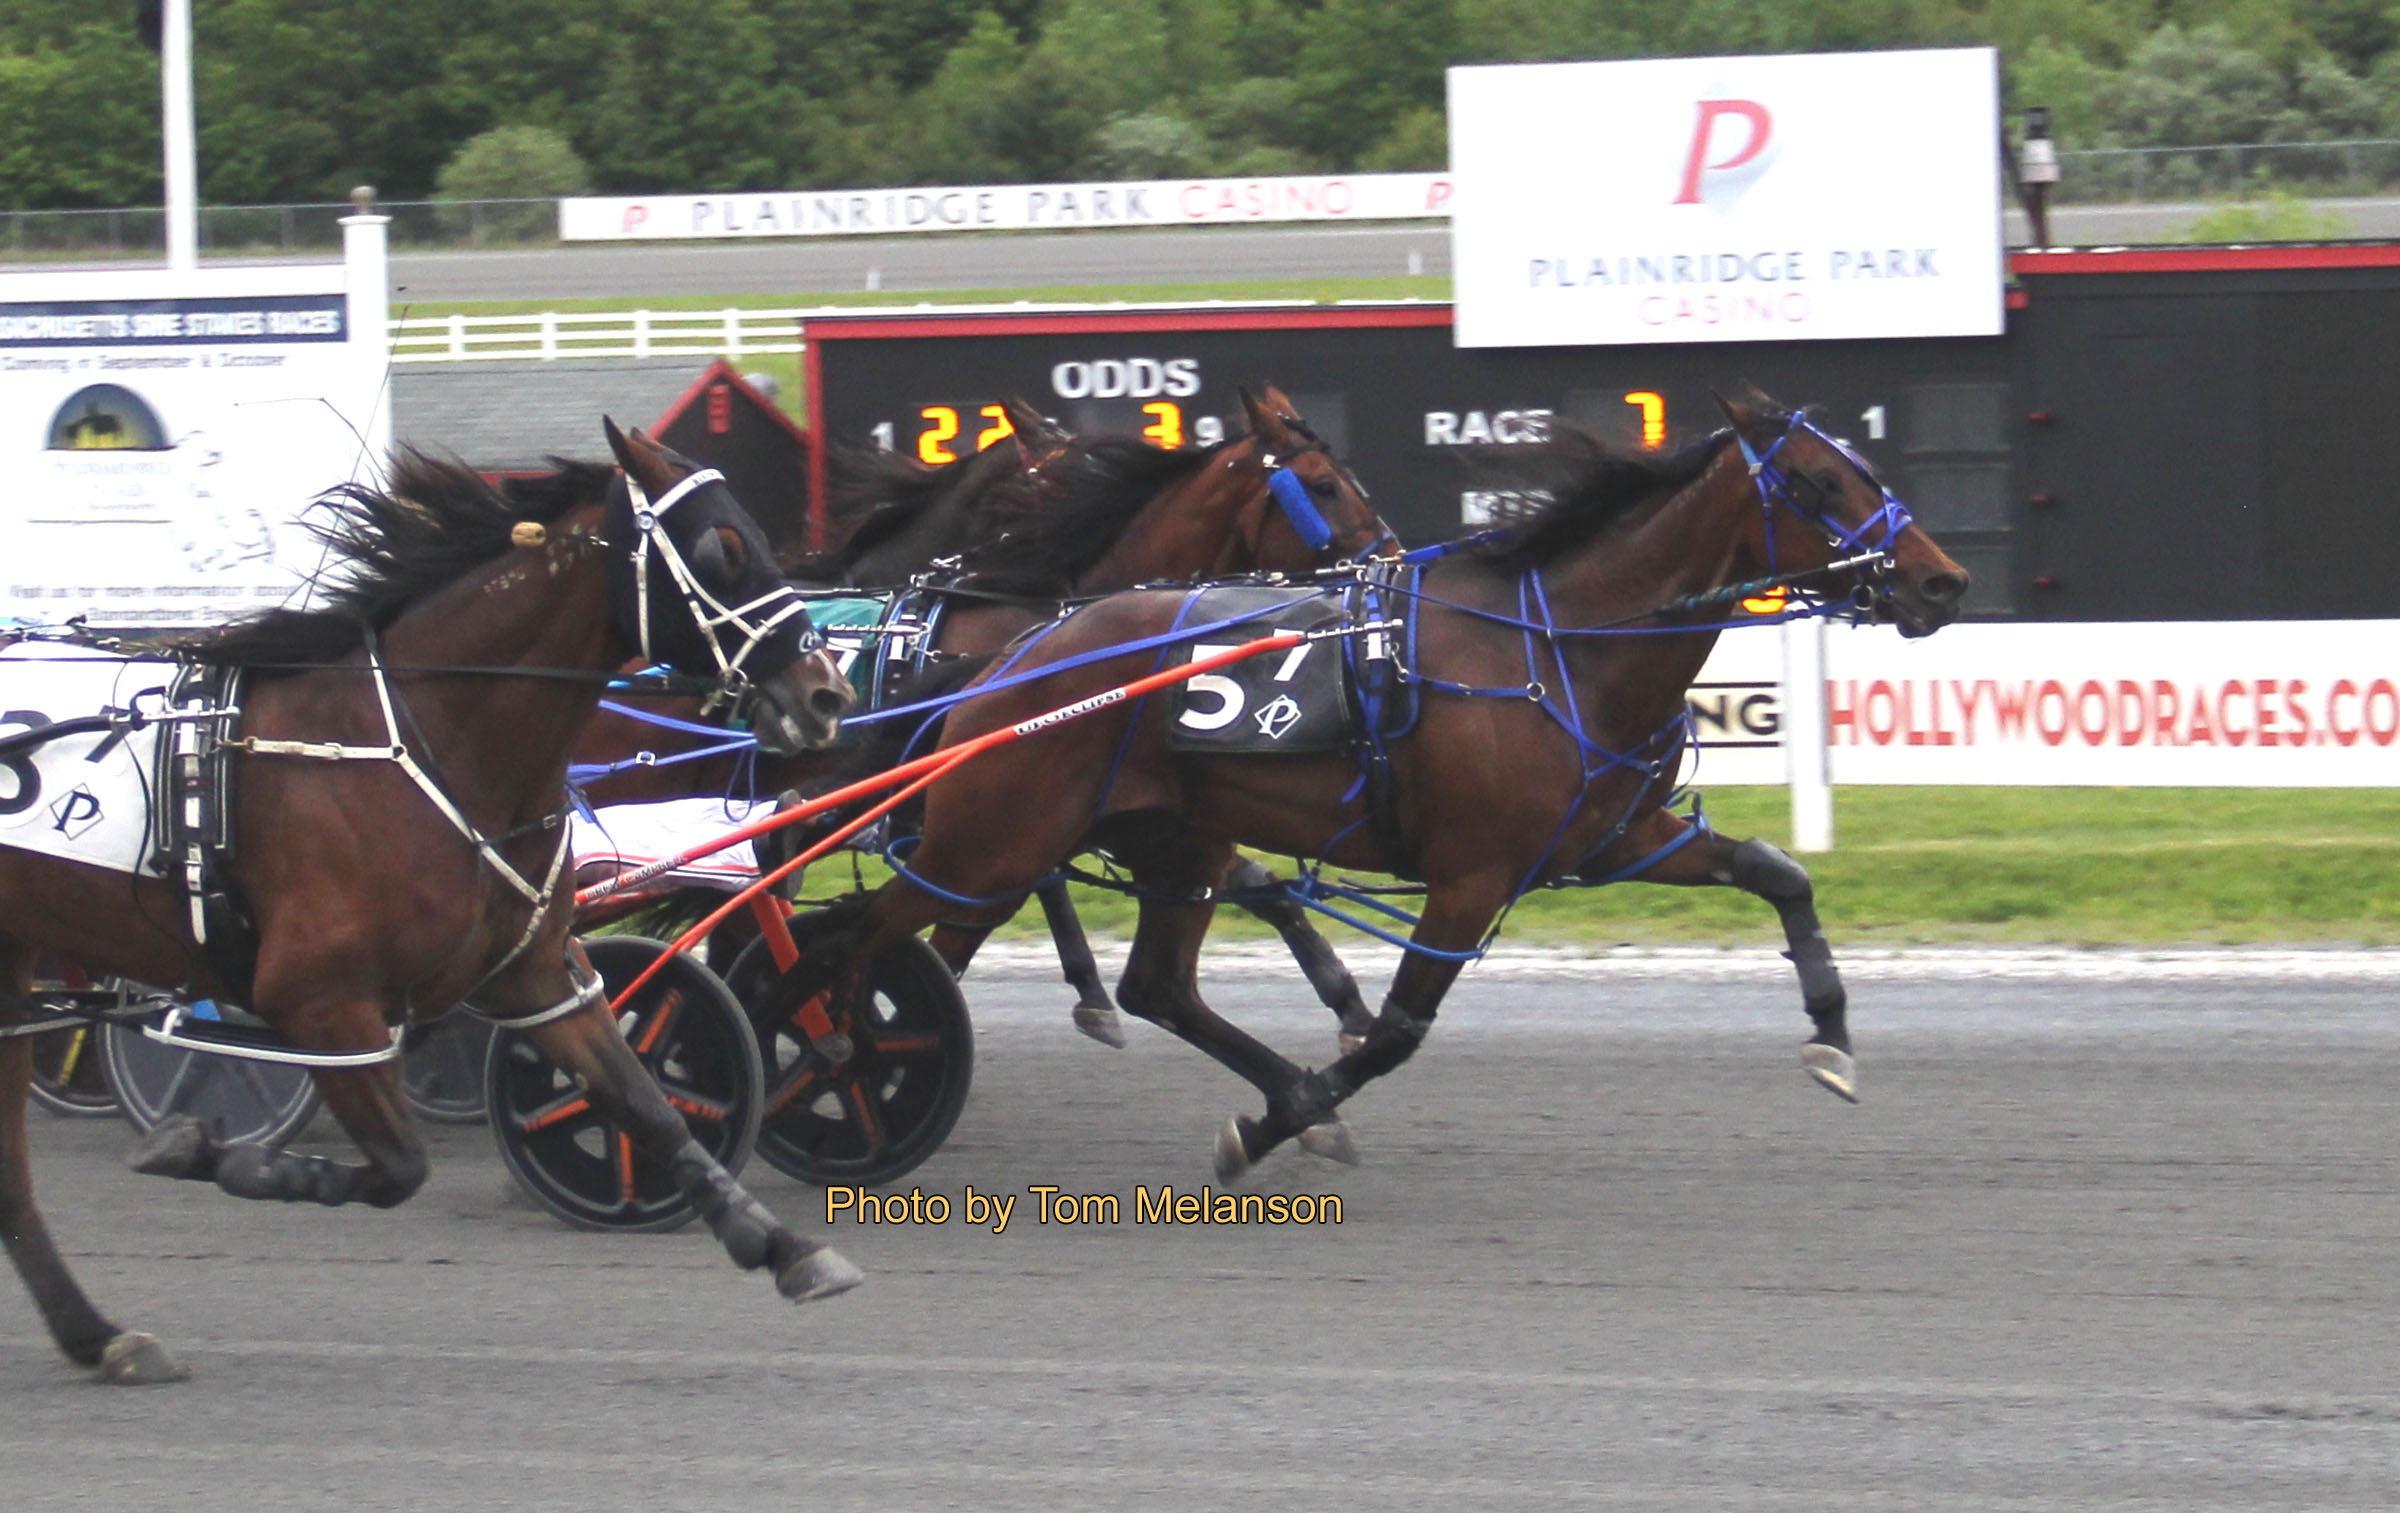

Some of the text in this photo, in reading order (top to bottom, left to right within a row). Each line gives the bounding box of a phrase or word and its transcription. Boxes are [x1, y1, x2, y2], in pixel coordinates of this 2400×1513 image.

[1671, 99, 1772, 205] P
[691, 193, 997, 233] PLAINRIDGE
[1027, 188, 1153, 223] PARK
[1179, 180, 1354, 218] CASINO
[1528, 248, 1940, 288] PLAINRIDGE PARK
[1638, 292, 1812, 326] CASINO
[1052, 358, 1200, 399] ODDS
[870, 421, 894, 454] 1
[1195, 415, 1225, 448] 9
[1424, 391, 1667, 449] RACE 7
[1861, 405, 1887, 439] 1
[826, 636, 863, 677] 7
[1179, 628, 1313, 730] 5 7
[1257, 697, 1299, 735] P
